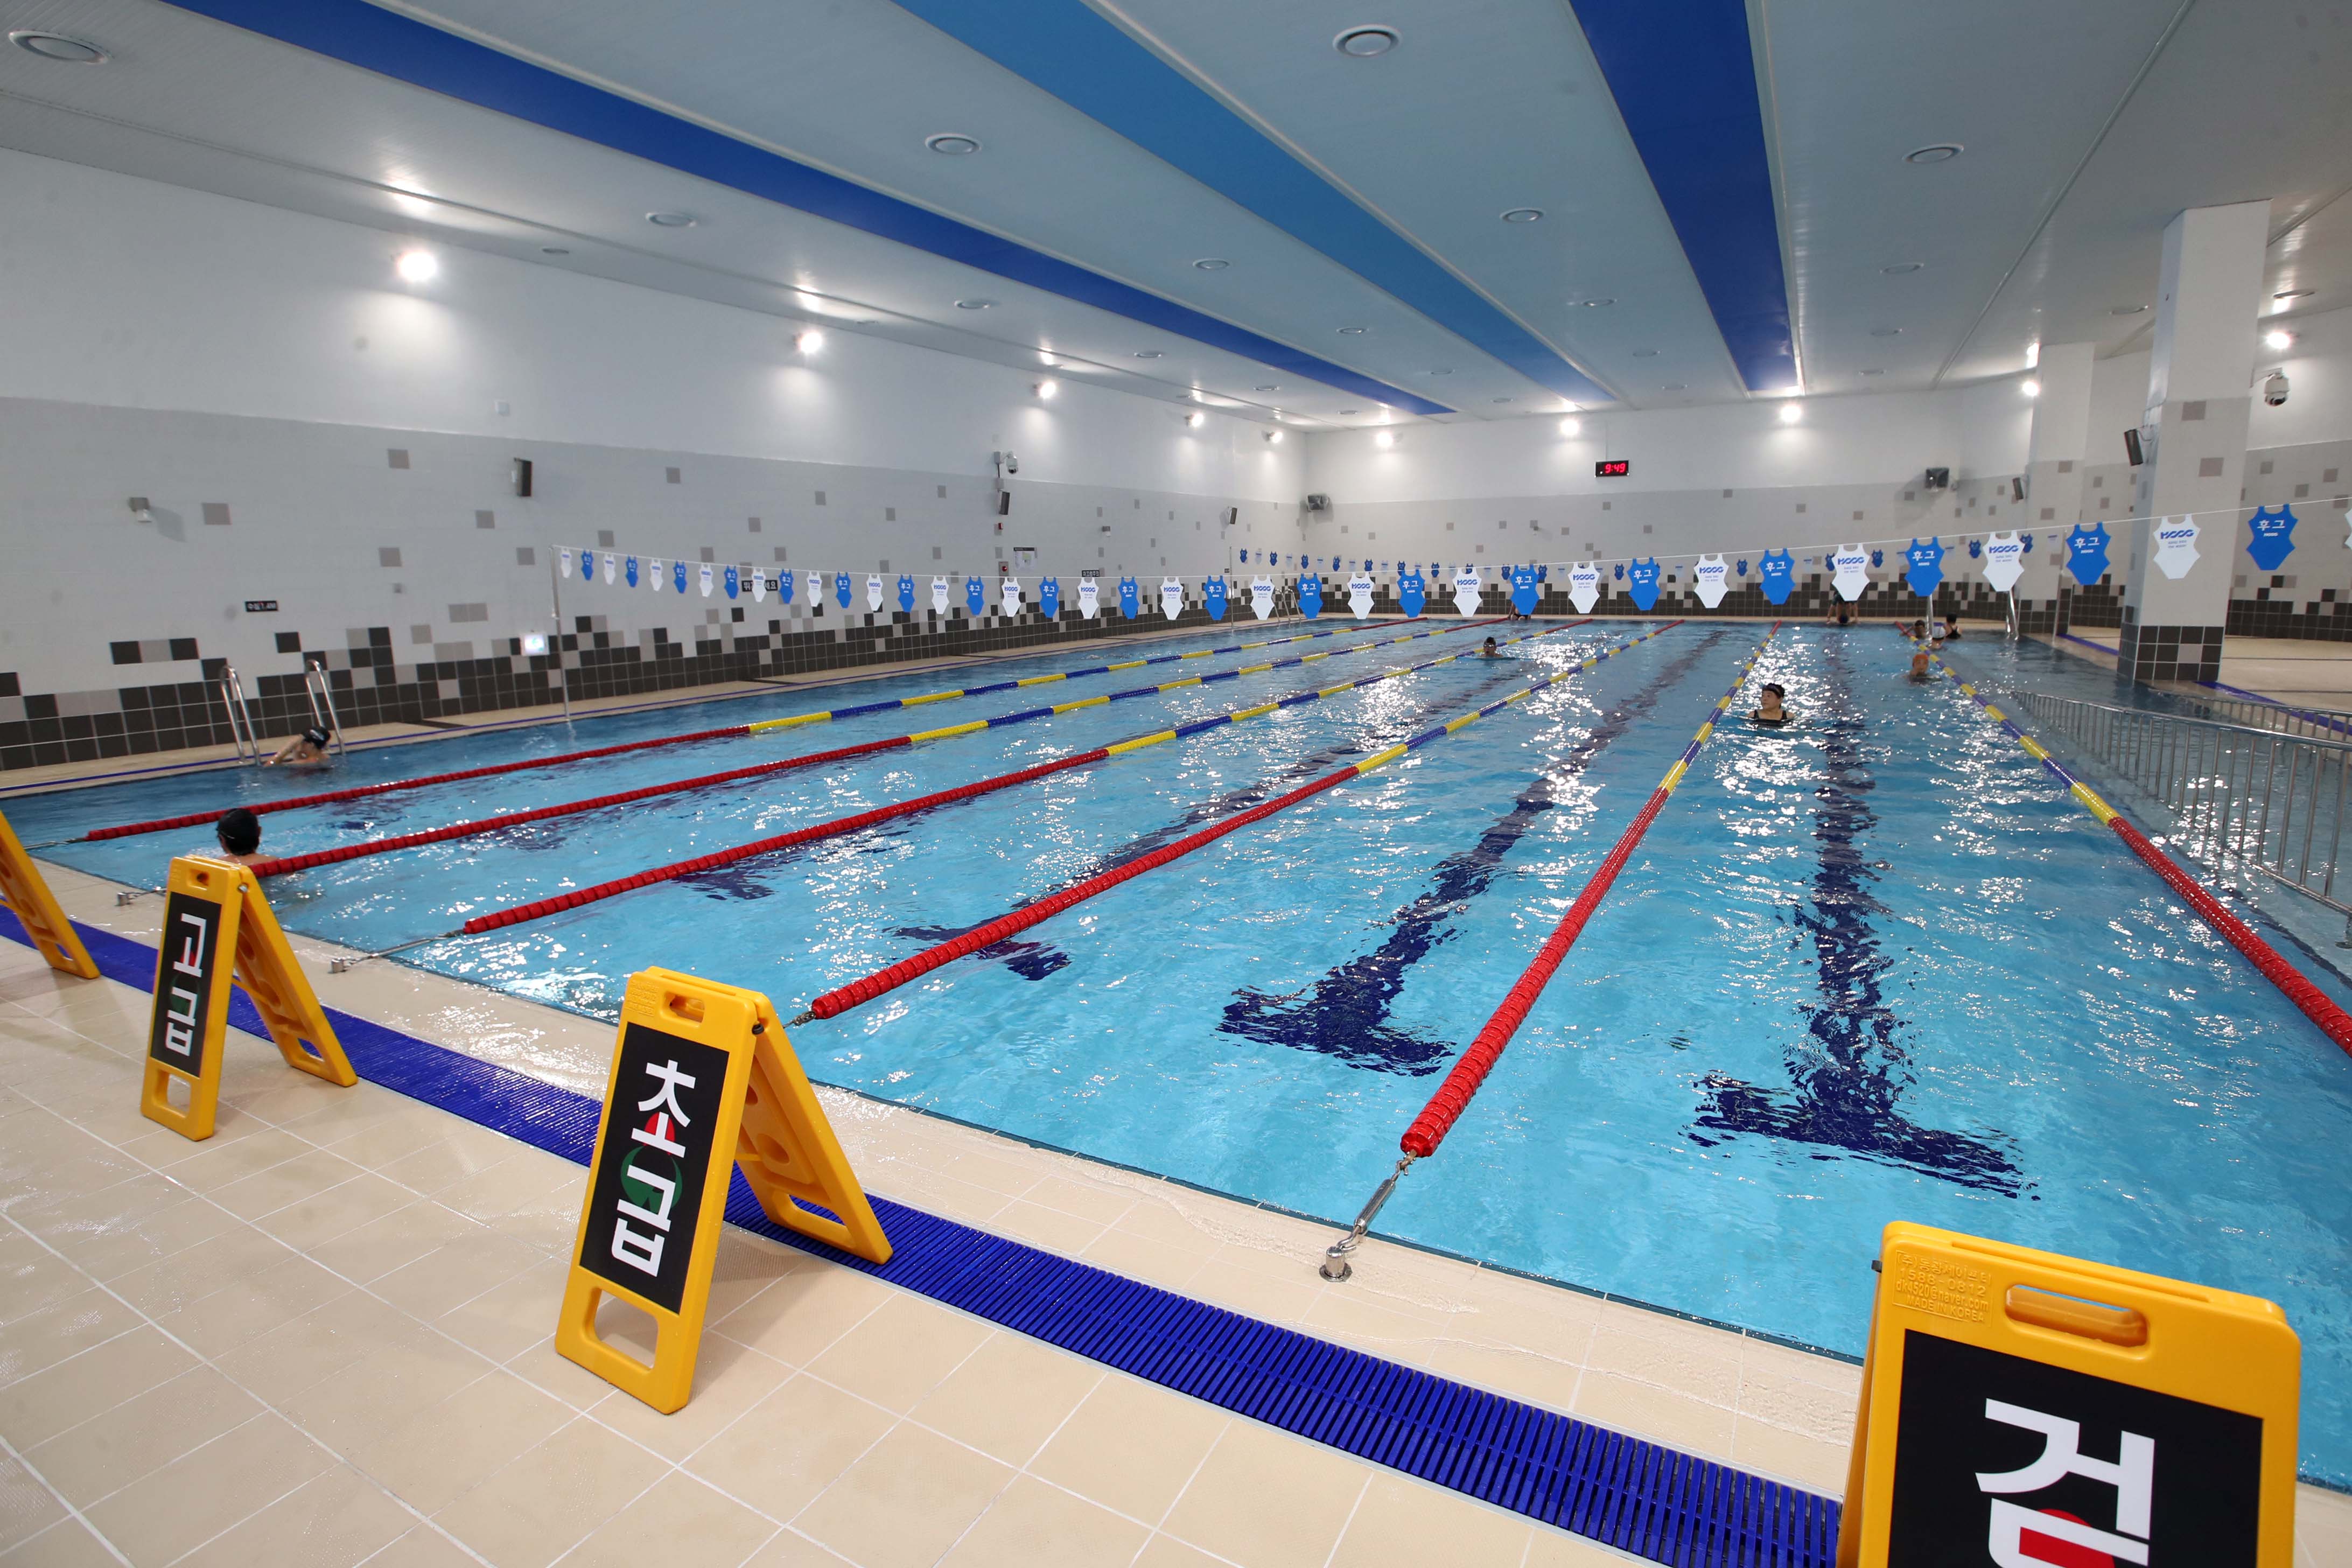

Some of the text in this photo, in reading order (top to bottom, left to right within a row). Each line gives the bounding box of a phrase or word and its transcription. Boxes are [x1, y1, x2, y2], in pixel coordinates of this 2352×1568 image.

[1605, 463, 1626, 473] 9:49
[2257, 520, 2285, 531] 후그
[2074, 537, 2100, 548] 후그
[1913, 551, 1935, 561] 후그
[1766, 562, 1786, 571] 후그
[1634, 570, 1652, 579] 후그
[1402, 580, 1419, 589] 후그
[1515, 576, 1532, 585] 후그
[1301, 584, 1317, 592] 후그
[166, 913, 206, 1056] 고급
[612, 1060, 696, 1277] 초급
[1896, 1279, 1989, 1310] dk4520@naver.com
[1907, 1295, 1985, 1322] MADE IN KOREA
